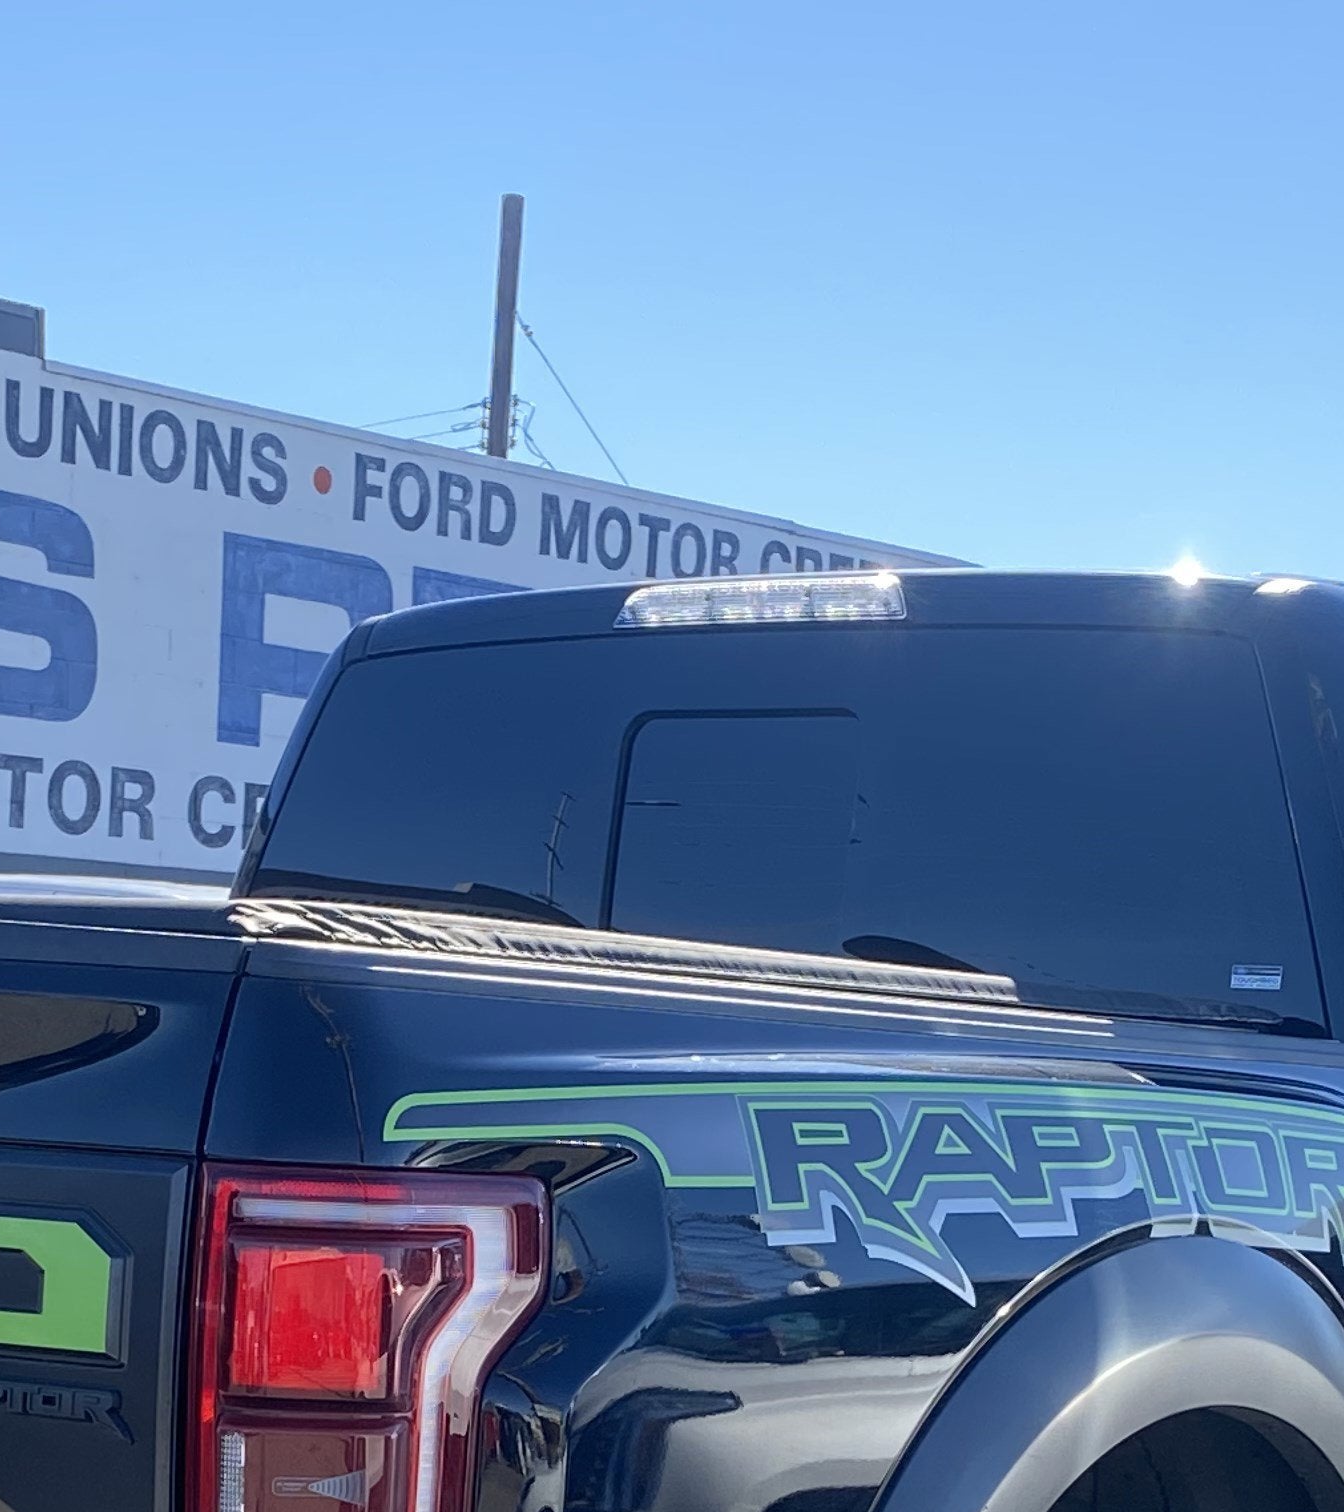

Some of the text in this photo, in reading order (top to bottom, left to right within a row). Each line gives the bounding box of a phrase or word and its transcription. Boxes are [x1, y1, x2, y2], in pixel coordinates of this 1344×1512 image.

[4, 379, 289, 506] UNIONS
[352, 453, 517, 547] FORD
[538, 492, 741, 579] MOTOR
